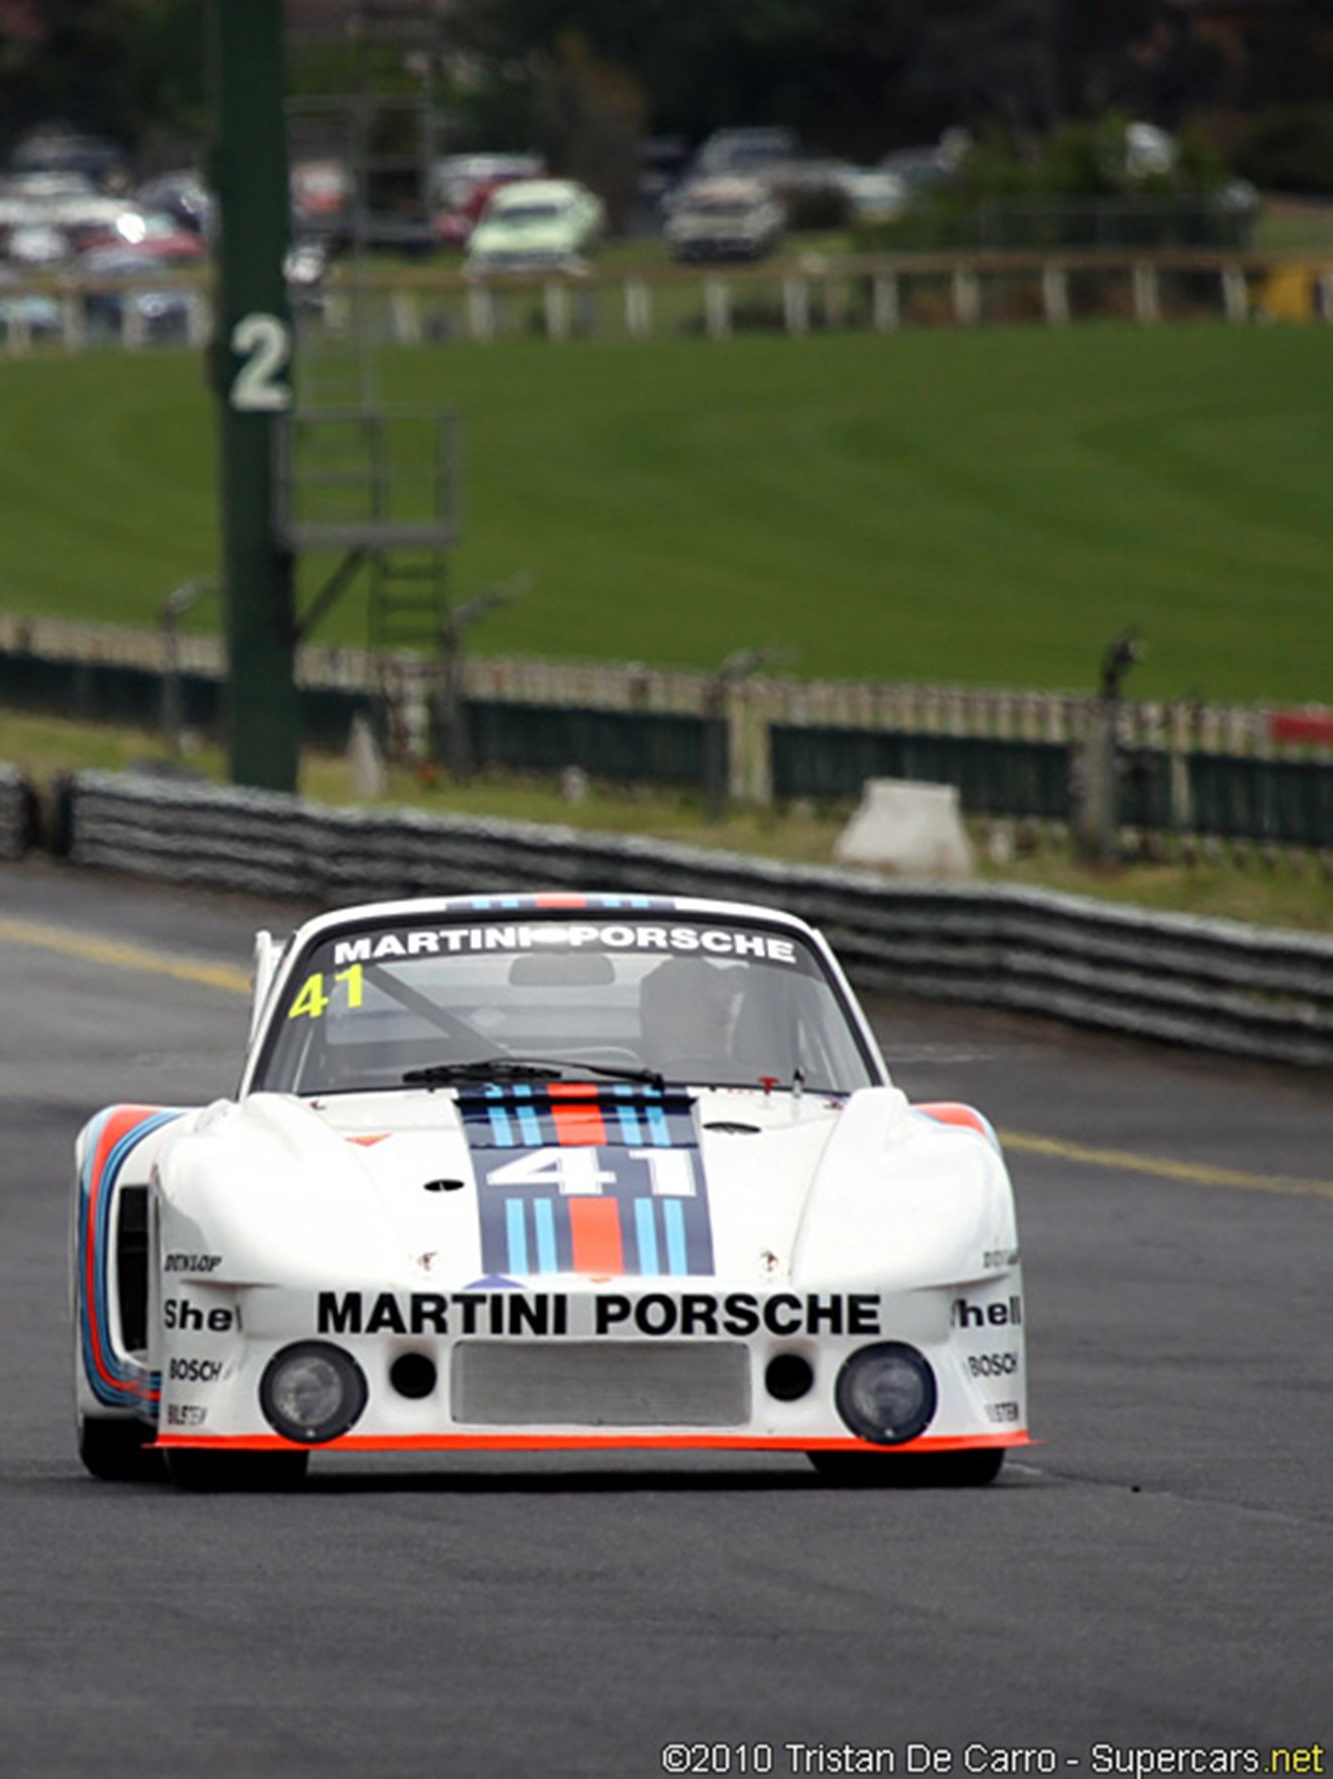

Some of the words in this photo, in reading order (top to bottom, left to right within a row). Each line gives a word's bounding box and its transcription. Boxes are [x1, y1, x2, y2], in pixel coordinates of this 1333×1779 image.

[232, 314, 288, 411] 2
[334, 927, 533, 963] MARTINI
[569, 925, 797, 963] PORSCHE
[288, 963, 364, 1019] 41
[486, 1147, 697, 1197] 41
[317, 1291, 567, 1335] MARTINI
[595, 1292, 882, 1336] PORSCHE
[169, 1357, 223, 1381] BOSCH
